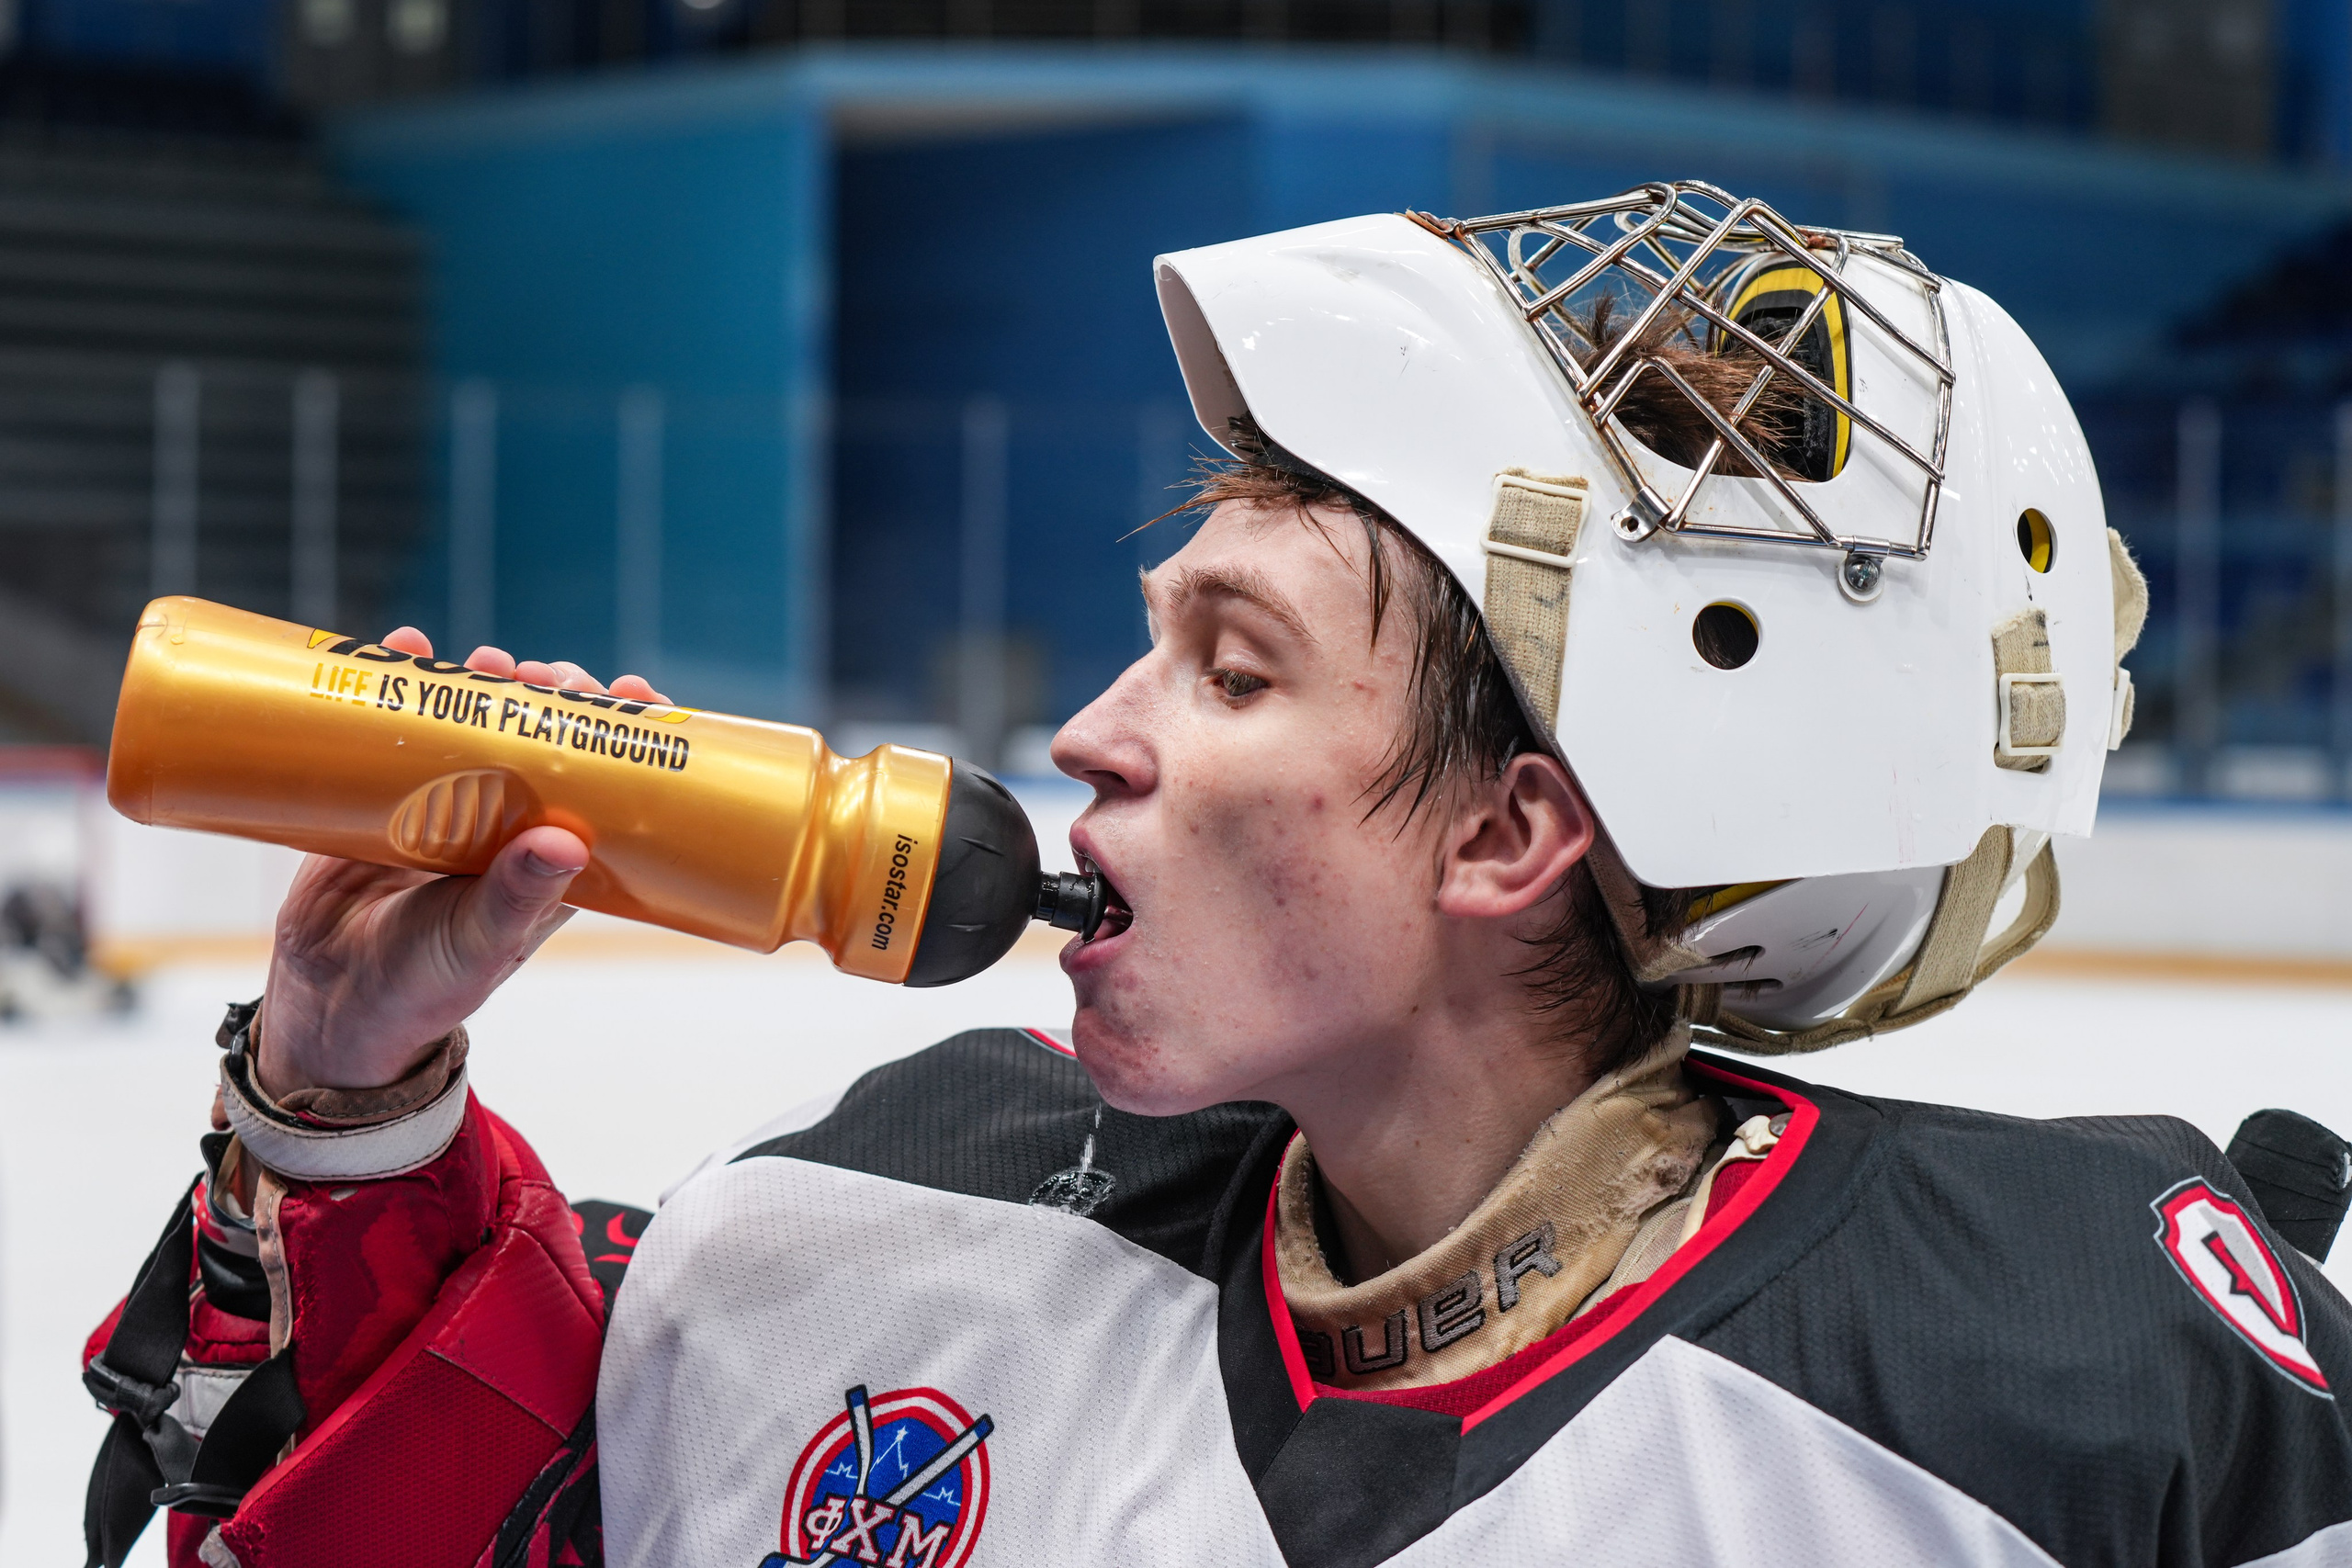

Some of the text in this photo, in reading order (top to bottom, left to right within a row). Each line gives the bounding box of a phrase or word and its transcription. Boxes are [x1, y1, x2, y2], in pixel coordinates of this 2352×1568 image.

[310, 662, 689, 772] LIFE IS YOUR PLAYGROUND
[871, 834, 918, 950] isostar.com
